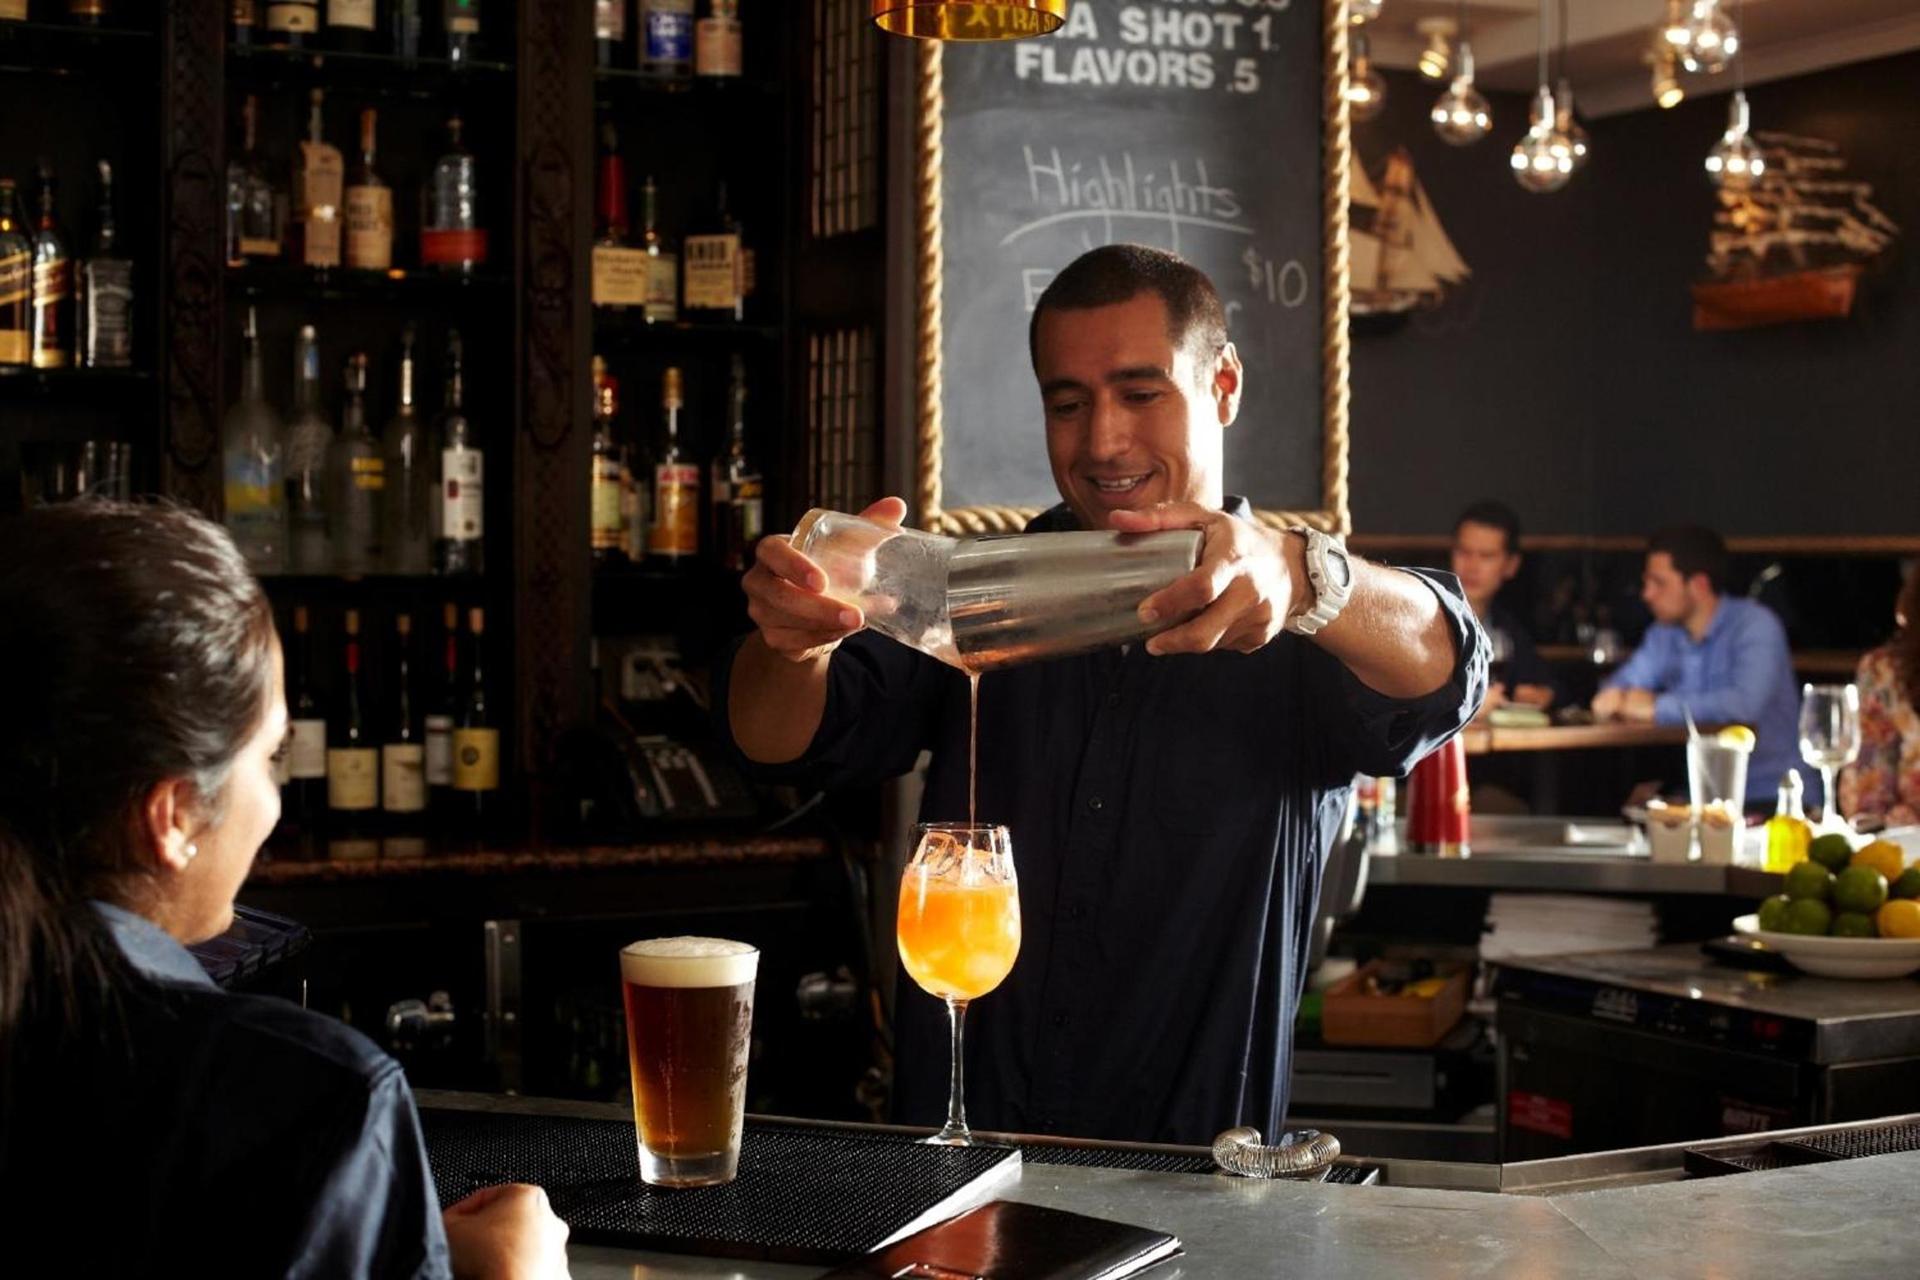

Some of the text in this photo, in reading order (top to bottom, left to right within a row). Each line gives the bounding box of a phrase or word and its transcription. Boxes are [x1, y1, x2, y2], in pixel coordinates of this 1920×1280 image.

[1118, 6, 1244, 49] SHOT
[1015, 42, 1216, 90] FLAVORS
[1023, 145, 1242, 250] Highlights
[1242, 247, 1308, 308] $10
